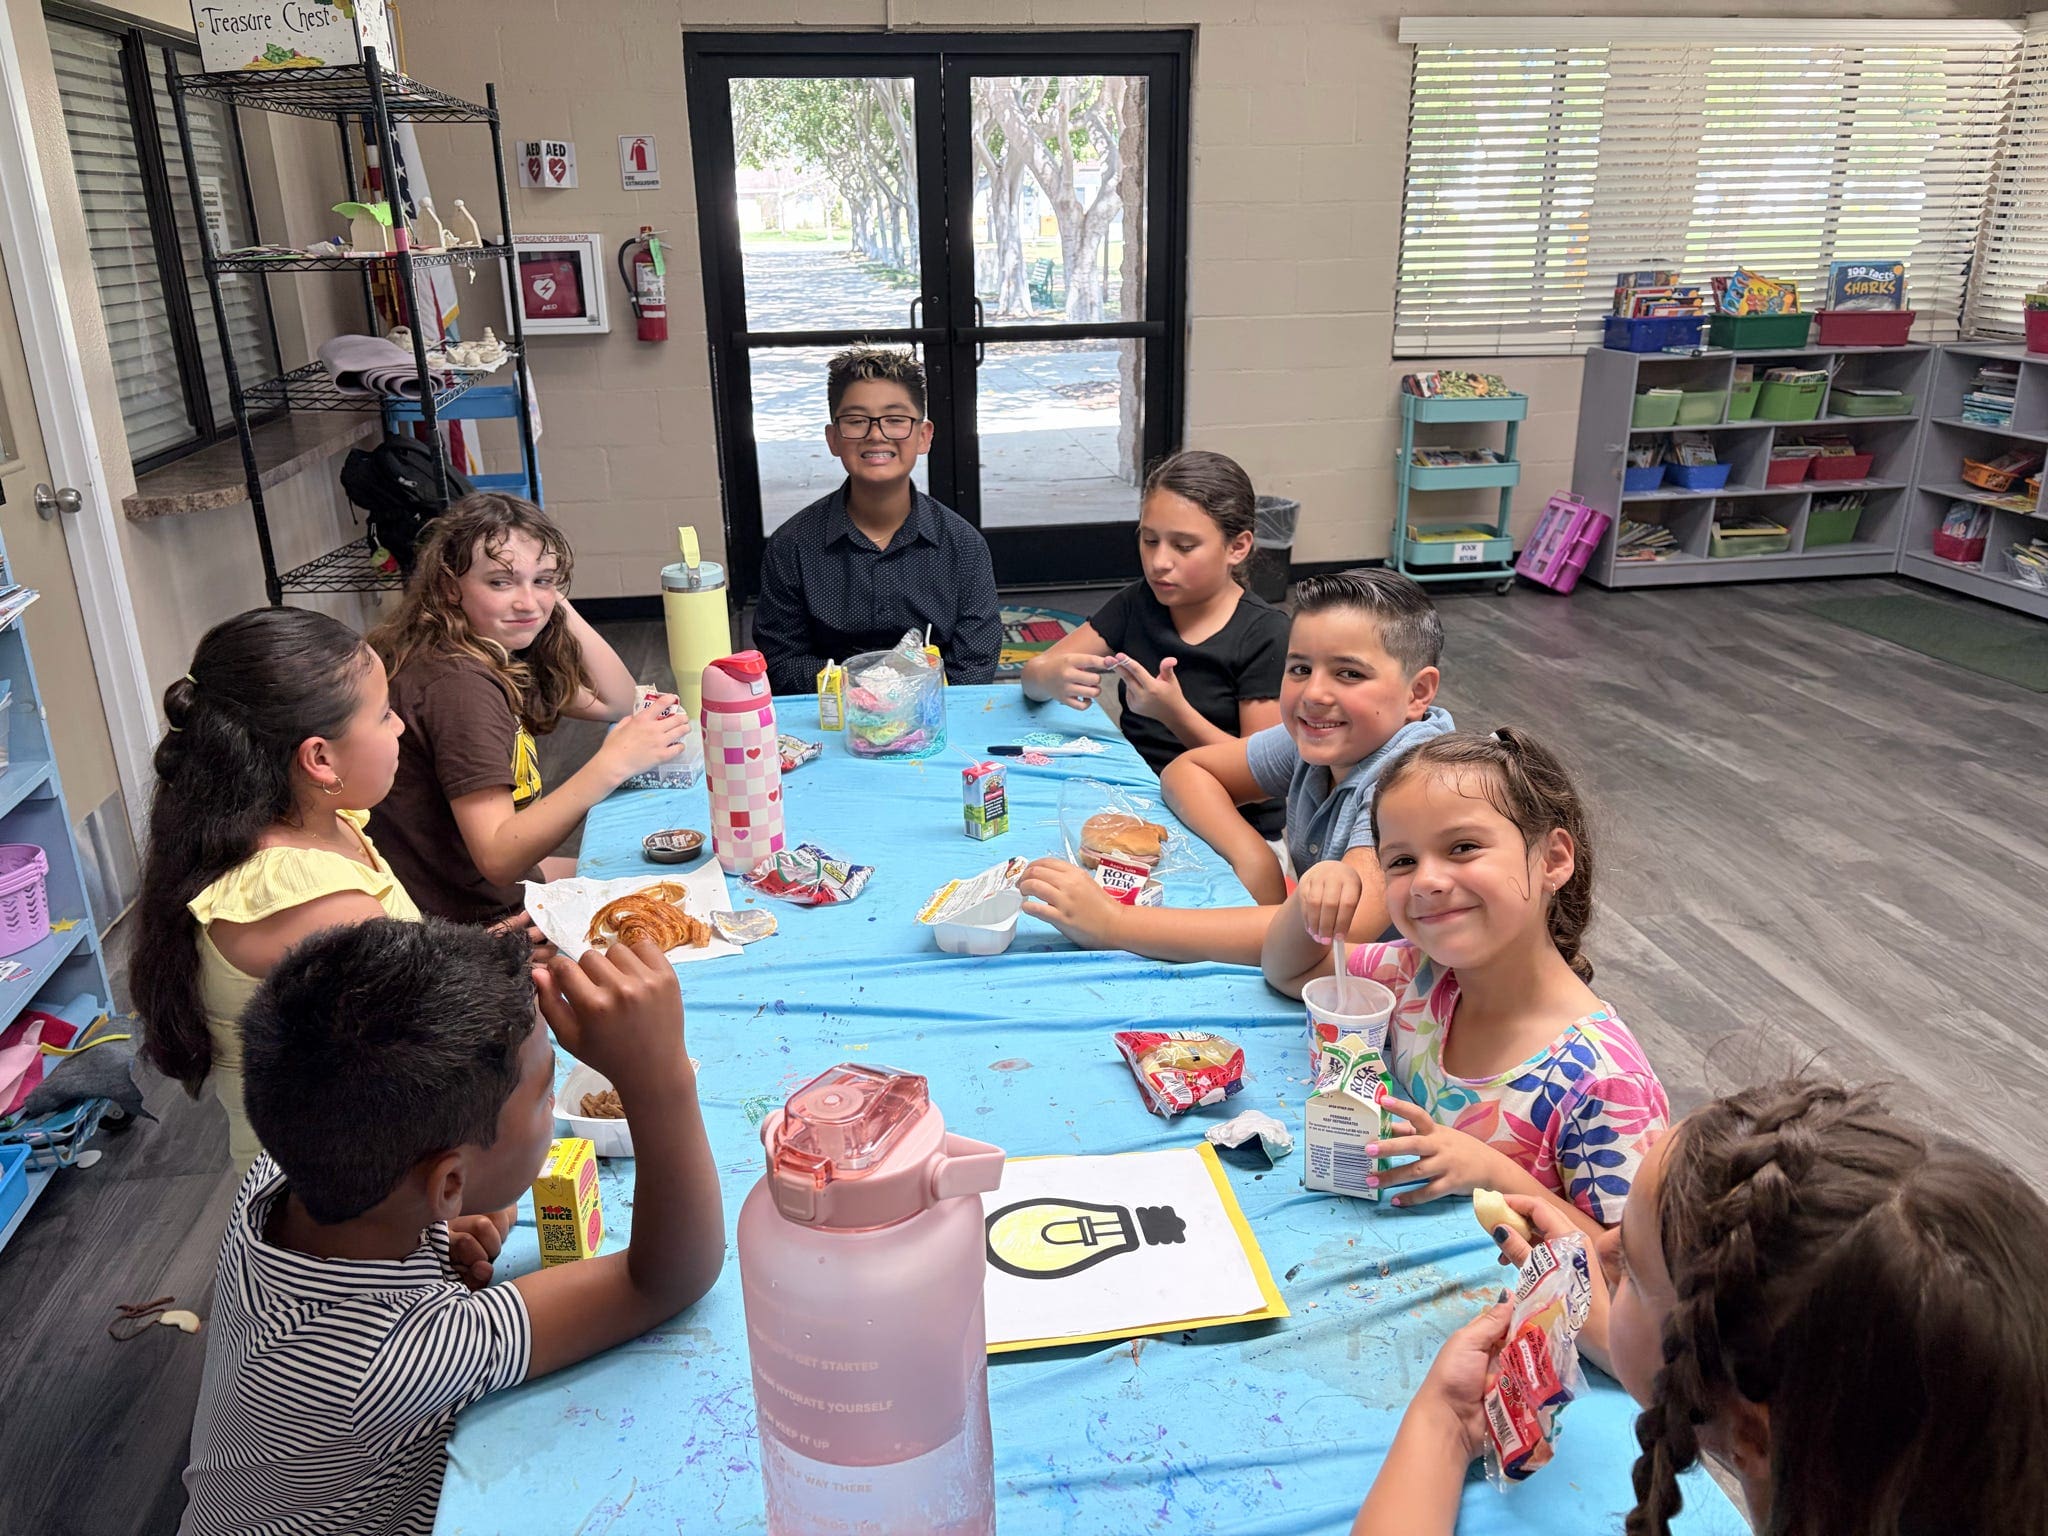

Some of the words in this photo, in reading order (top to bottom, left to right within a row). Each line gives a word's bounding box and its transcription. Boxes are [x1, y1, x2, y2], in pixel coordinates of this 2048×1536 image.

[201, 7, 272, 35] Treasure
[282, 2, 331, 33] Chest
[526, 142, 541, 157] AED
[546, 142, 566, 157] AED
[1847, 267, 1866, 276] 100
[1868, 269, 1896, 280] facts
[1843, 280, 1897, 295] SHARKS
[1102, 868, 1138, 883] ROCK
[1102, 877, 1134, 889] VIEW
[1350, 1065, 1376, 1096] ROCK
[1361, 1073, 1381, 1100] VIEW
[542, 1213, 573, 1221] JUICE
[1526, 1266, 1537, 1283] 30
[821, 1359, 880, 1372] STARTED
[775, 1382, 825, 1410] HYDRATE
[828, 1400, 895, 1413] YOURSELF
[799, 1433, 810, 1445] IT
[813, 1438, 830, 1450] UP
[804, 1474, 829, 1489] WAY
[832, 1482, 873, 1493] THERE
